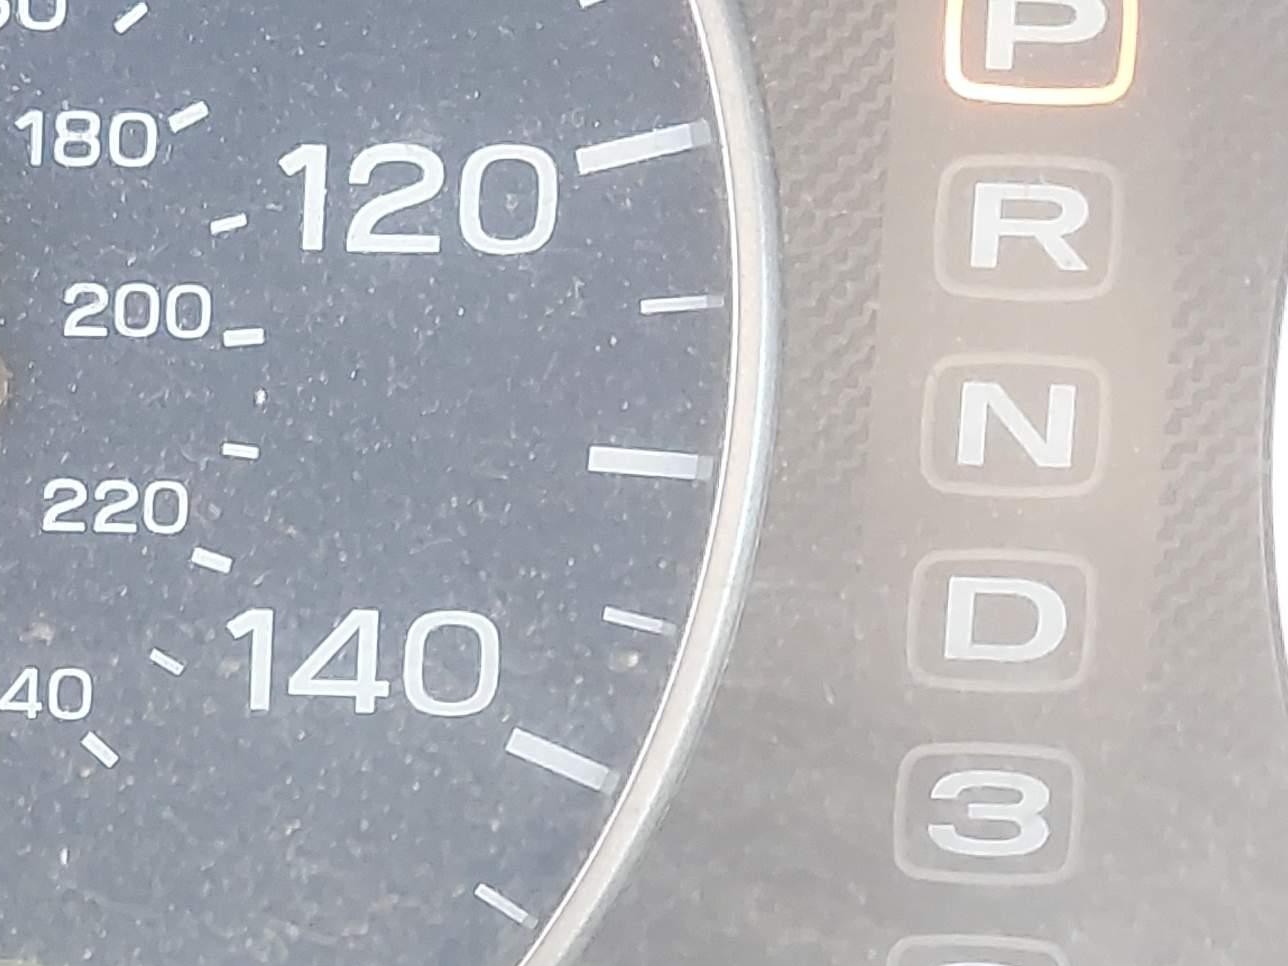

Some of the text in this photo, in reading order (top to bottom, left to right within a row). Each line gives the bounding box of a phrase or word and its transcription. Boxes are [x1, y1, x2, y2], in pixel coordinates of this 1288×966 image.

[984, 0, 1108, 70] P
[14, 109, 158, 168] 180
[278, 142, 559, 256] 120
[969, 182, 1089, 271] R
[62, 282, 212, 339] 200
[957, 381, 1076, 468] N
[40, 477, 189, 535] 220
[226, 607, 500, 717] 140
[944, 576, 1066, 662] D
[927, 769, 1050, 857] 3
